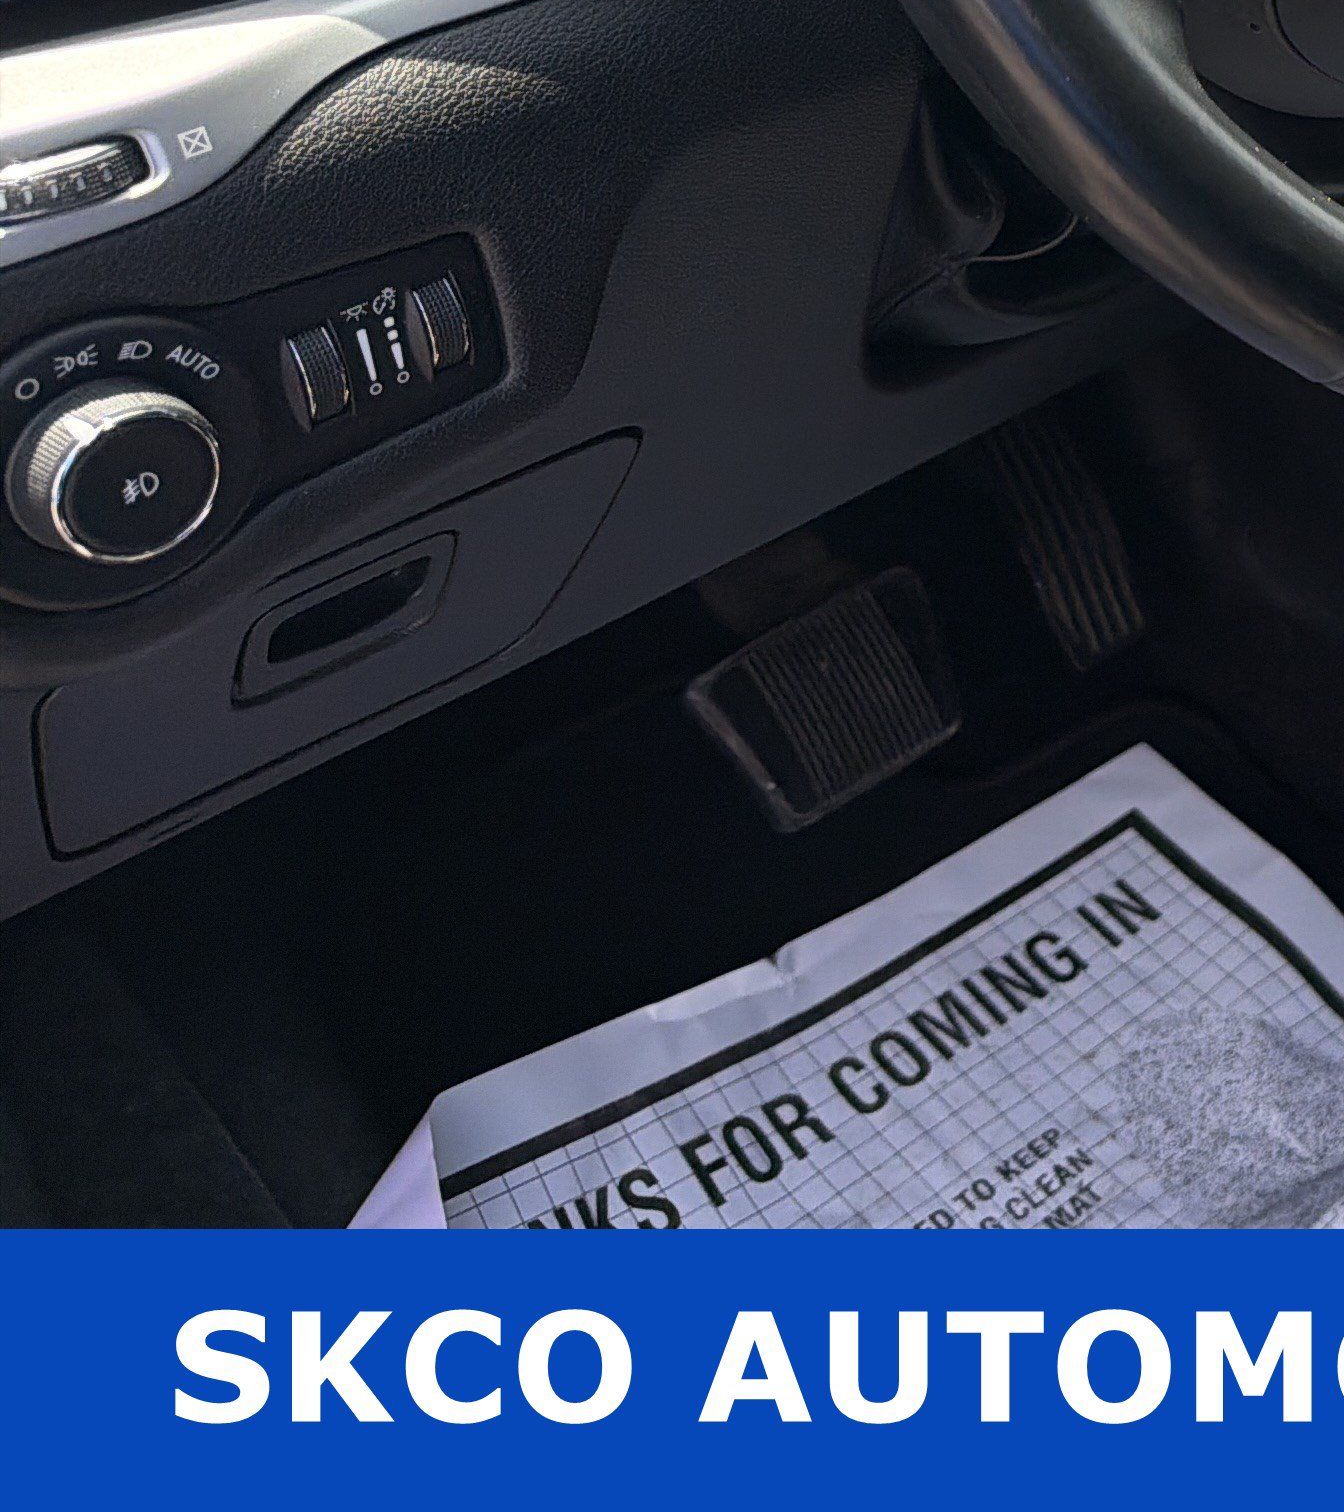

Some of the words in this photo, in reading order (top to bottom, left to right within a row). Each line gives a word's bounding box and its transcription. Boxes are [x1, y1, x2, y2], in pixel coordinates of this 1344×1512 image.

[166, 344, 220, 380] AUTO
[680, 1093, 836, 1208] FOR
[828, 930, 1089, 1114] COMING
[1077, 878, 1163, 948] IN
[953, 1178, 997, 1211] TO
[996, 1128, 1060, 1183] KEEP
[1005, 1148, 1093, 1221] CLEAN
